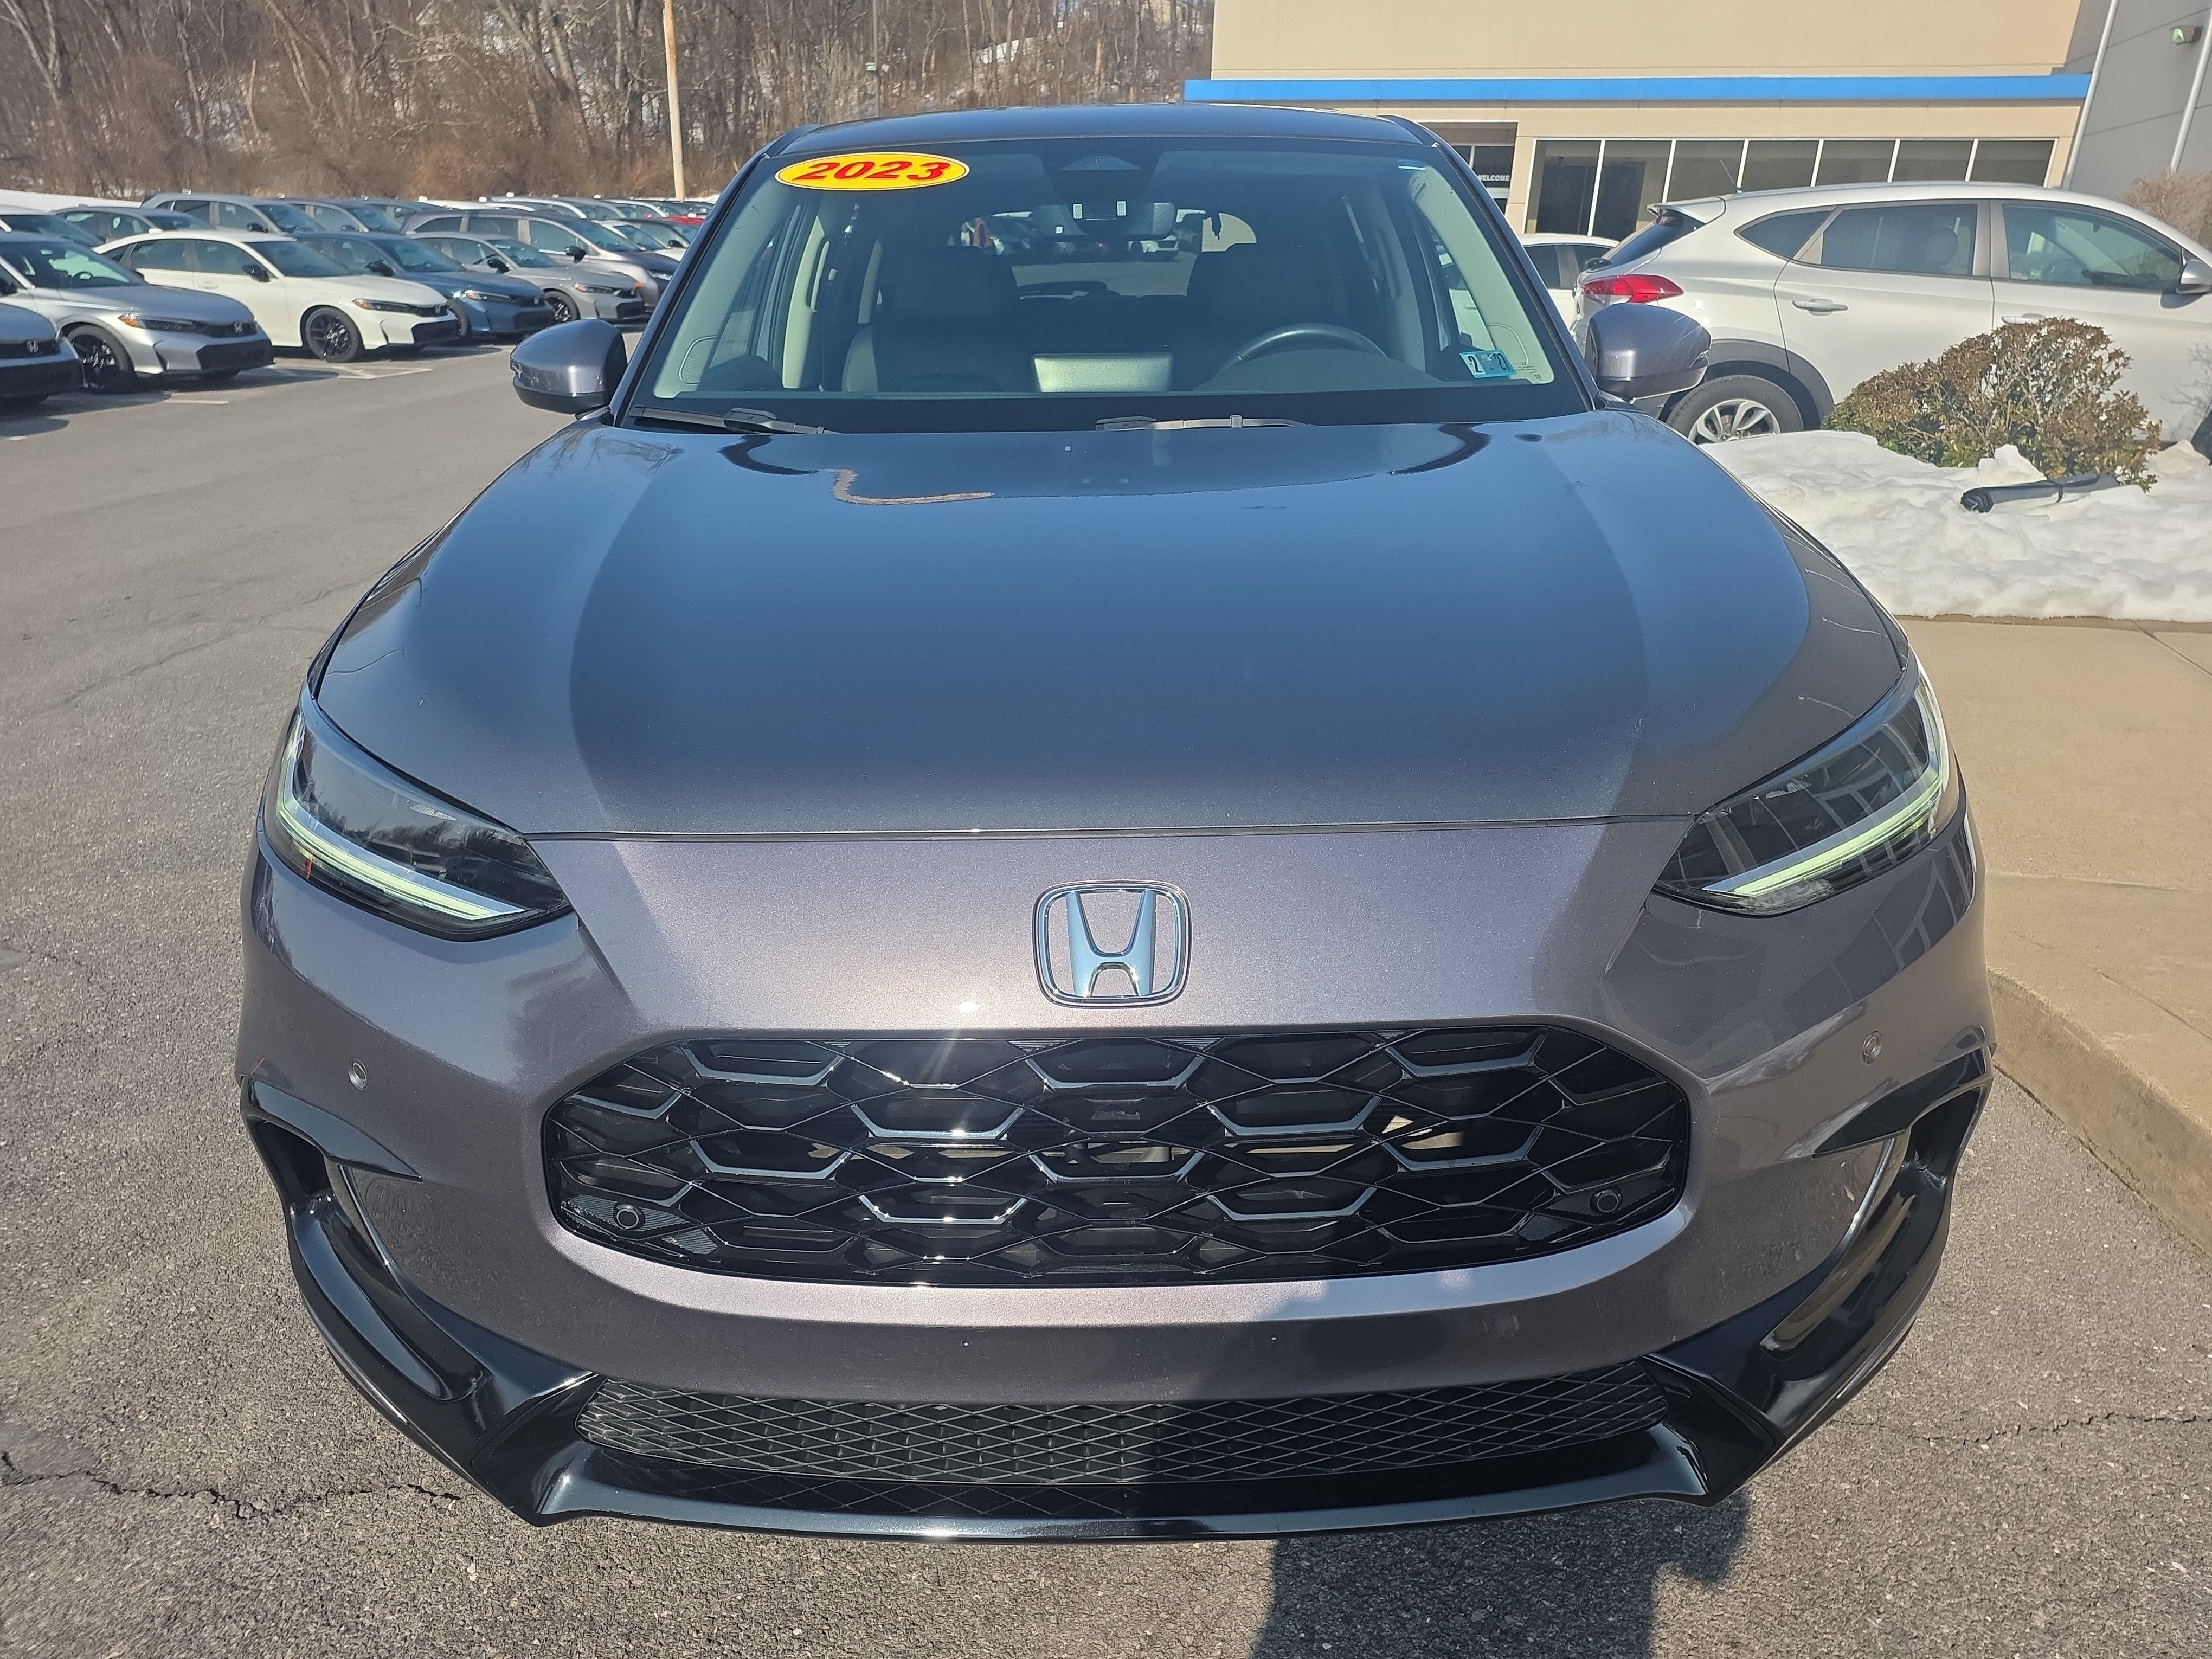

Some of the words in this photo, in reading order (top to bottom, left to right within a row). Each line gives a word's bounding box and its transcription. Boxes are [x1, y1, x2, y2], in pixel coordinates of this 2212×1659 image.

[792, 160, 952, 182] 2023
[1467, 356, 1483, 373] 2
[1493, 353, 1510, 371] 27
